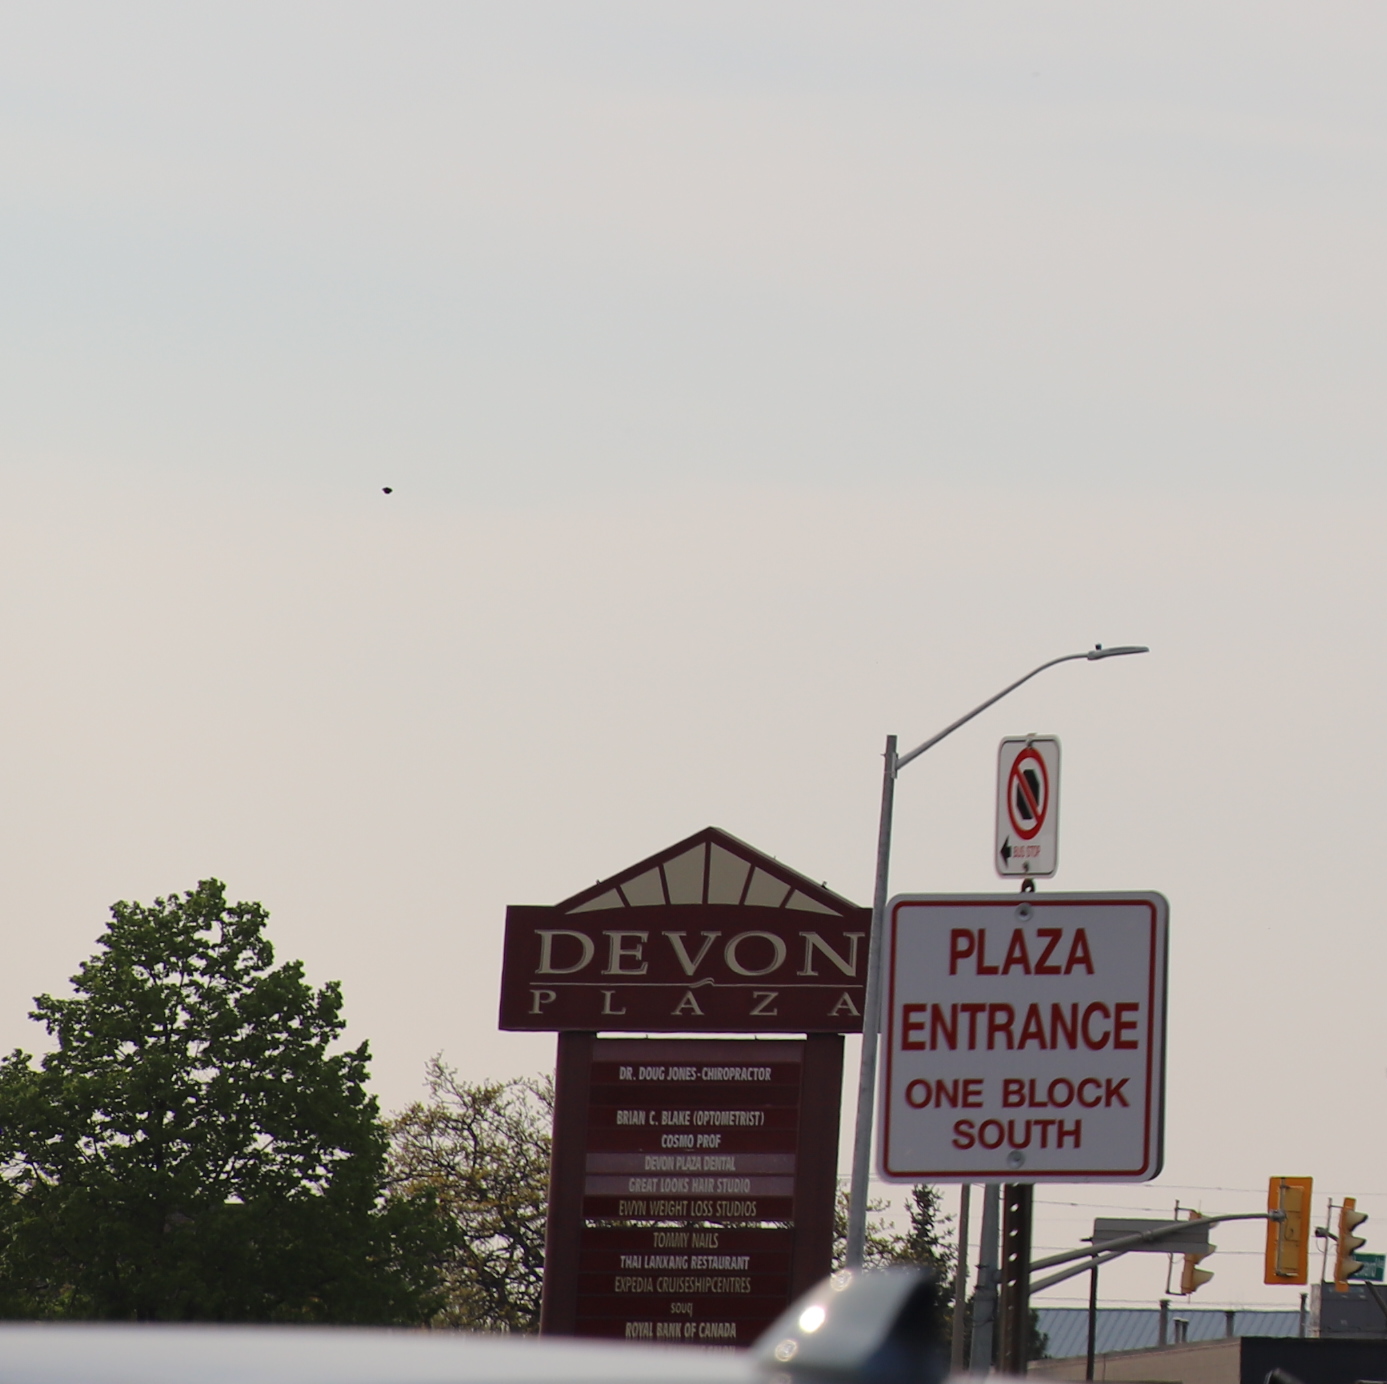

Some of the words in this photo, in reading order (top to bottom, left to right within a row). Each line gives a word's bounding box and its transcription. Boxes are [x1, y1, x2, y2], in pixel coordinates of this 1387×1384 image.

[1026, 845, 1041, 857] STOP
[534, 929, 865, 977] DEVON
[948, 928, 1095, 976] PLAZA
[528, 990, 861, 1016] PLAZA
[901, 1001, 1140, 1051] ENTRANCE
[619, 1066, 636, 1081] DR.
[639, 1066, 665, 1081] DOUG
[905, 1078, 984, 1109] ONE
[1001, 1077, 1130, 1108] BLOCK
[616, 1110, 645, 1125] BRIAN
[649, 1111, 658, 1125] C.
[661, 1110, 690, 1126] BLAKE
[693, 1111, 765, 1126] (OPTOMETRIST)
[661, 1134, 694, 1148] COSMO
[697, 1134, 722, 1148] PROF
[952, 1119, 1082, 1149] SOUTH
[645, 1156, 674, 1171] DEVON
[676, 1156, 702, 1171] PLAZA
[703, 1156, 736, 1171] DENTAL
[628, 1178, 658, 1192] GREAT
[660, 1178, 689, 1192] LOOKS
[691, 1178, 714, 1193] HAIR
[717, 1179, 751, 1193] STUDIO
[649, 1200, 688, 1216] WEIGHT
[690, 1201, 713, 1216] LOSS
[715, 1201, 757, 1217] STUDIOS
[653, 1232, 690, 1248] TOMMY
[691, 1232, 719, 1249] NAILS
[620, 1255, 641, 1269] THAI
[644, 1255, 688, 1269] LANXANG
[690, 1256, 750, 1270] RESTAURANT
[614, 1276, 654, 1293] EXPEDIA
[656, 1277, 751, 1294] CRUISESHIPCENTRES
[670, 1302, 693, 1317] souq
[625, 1322, 653, 1338] ROYAL
[656, 1322, 682, 1338] BANK
[684, 1322, 696, 1338] OF
[698, 1322, 736, 1338] CANADA
